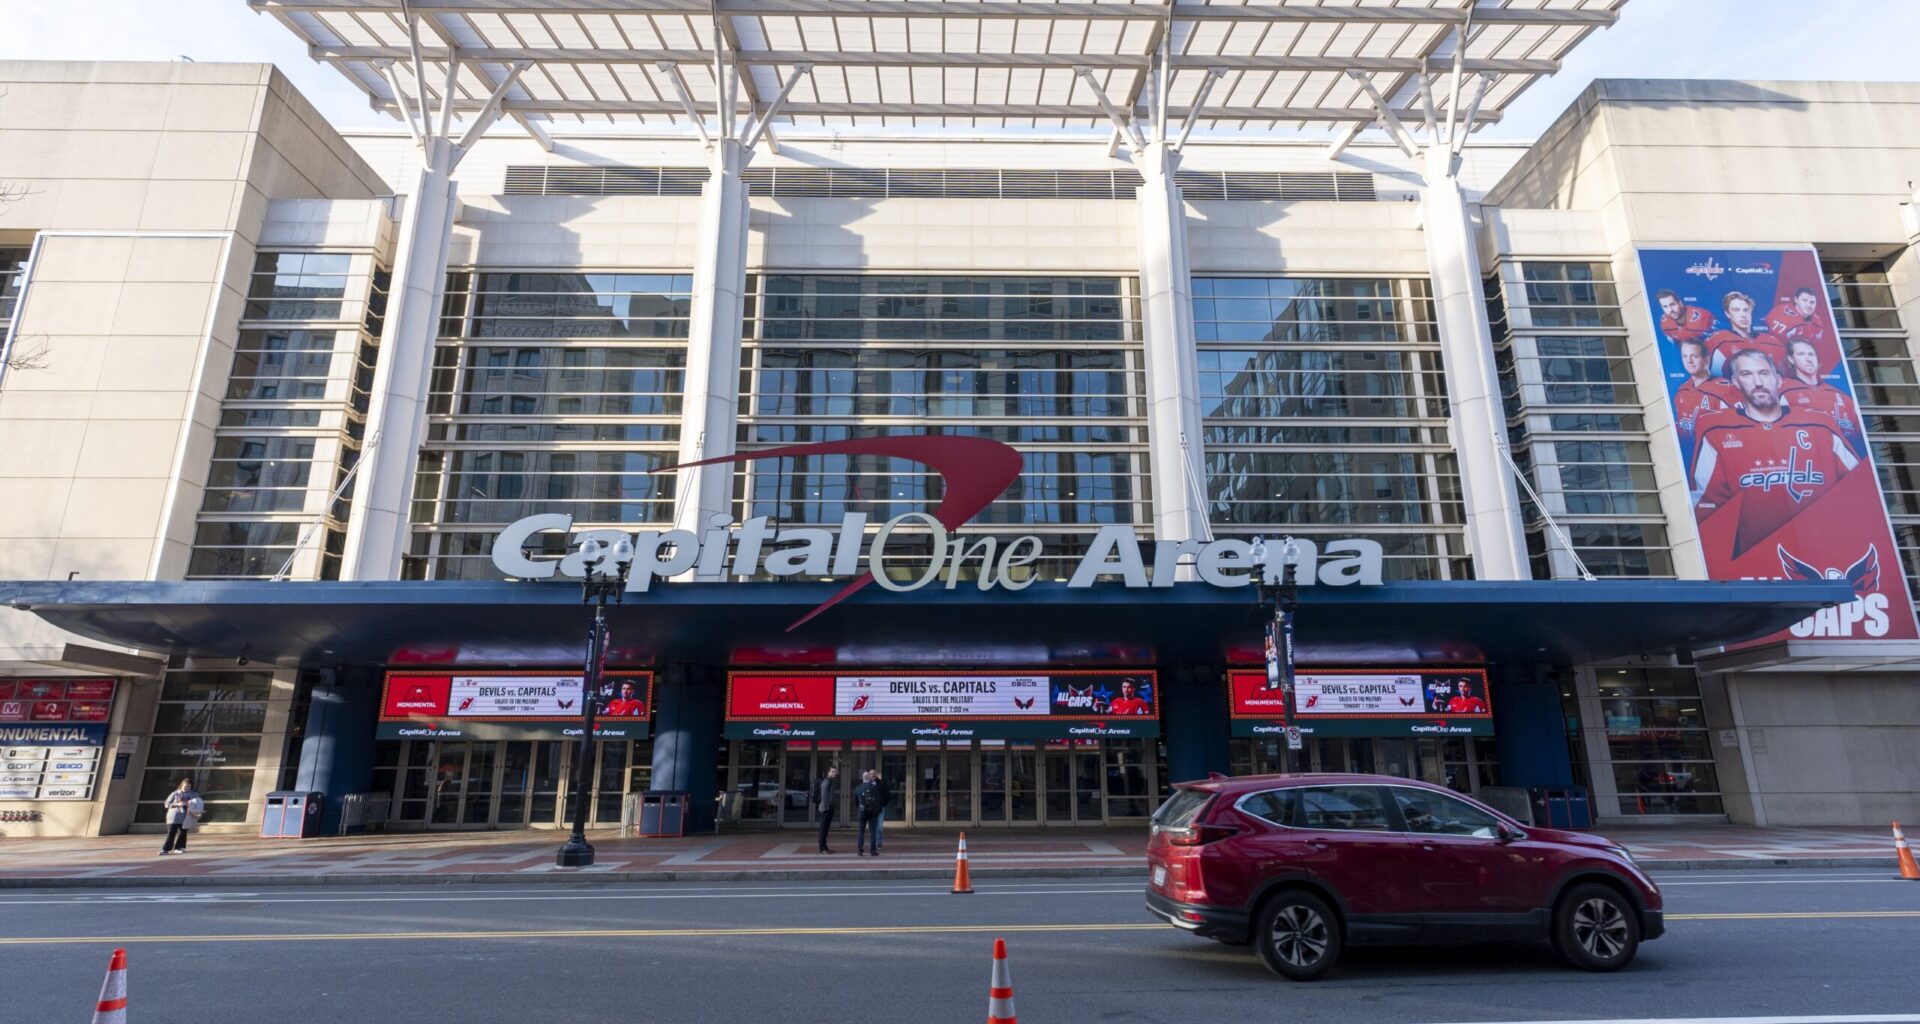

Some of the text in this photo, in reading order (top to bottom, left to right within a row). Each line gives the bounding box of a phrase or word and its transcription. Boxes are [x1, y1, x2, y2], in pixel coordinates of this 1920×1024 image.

[1796, 430, 1812, 449] C
[1739, 446, 1825, 503] capitals
[1067, 525, 1384, 588] Arena
[480, 688, 506, 696] DEVILS
[518, 687, 556, 696] CAPITALS
[890, 682, 926, 693] DEVILS
[944, 682, 996, 693] CAPITALS
[1322, 685, 1347, 694] DEVILS
[1359, 685, 1396, 694] CAPITALS
[912, 696, 974, 704] SALUTE TO THE MILITARY
[1057, 692, 1069, 702] ALL
[1068, 697, 1093, 707] CAPS
